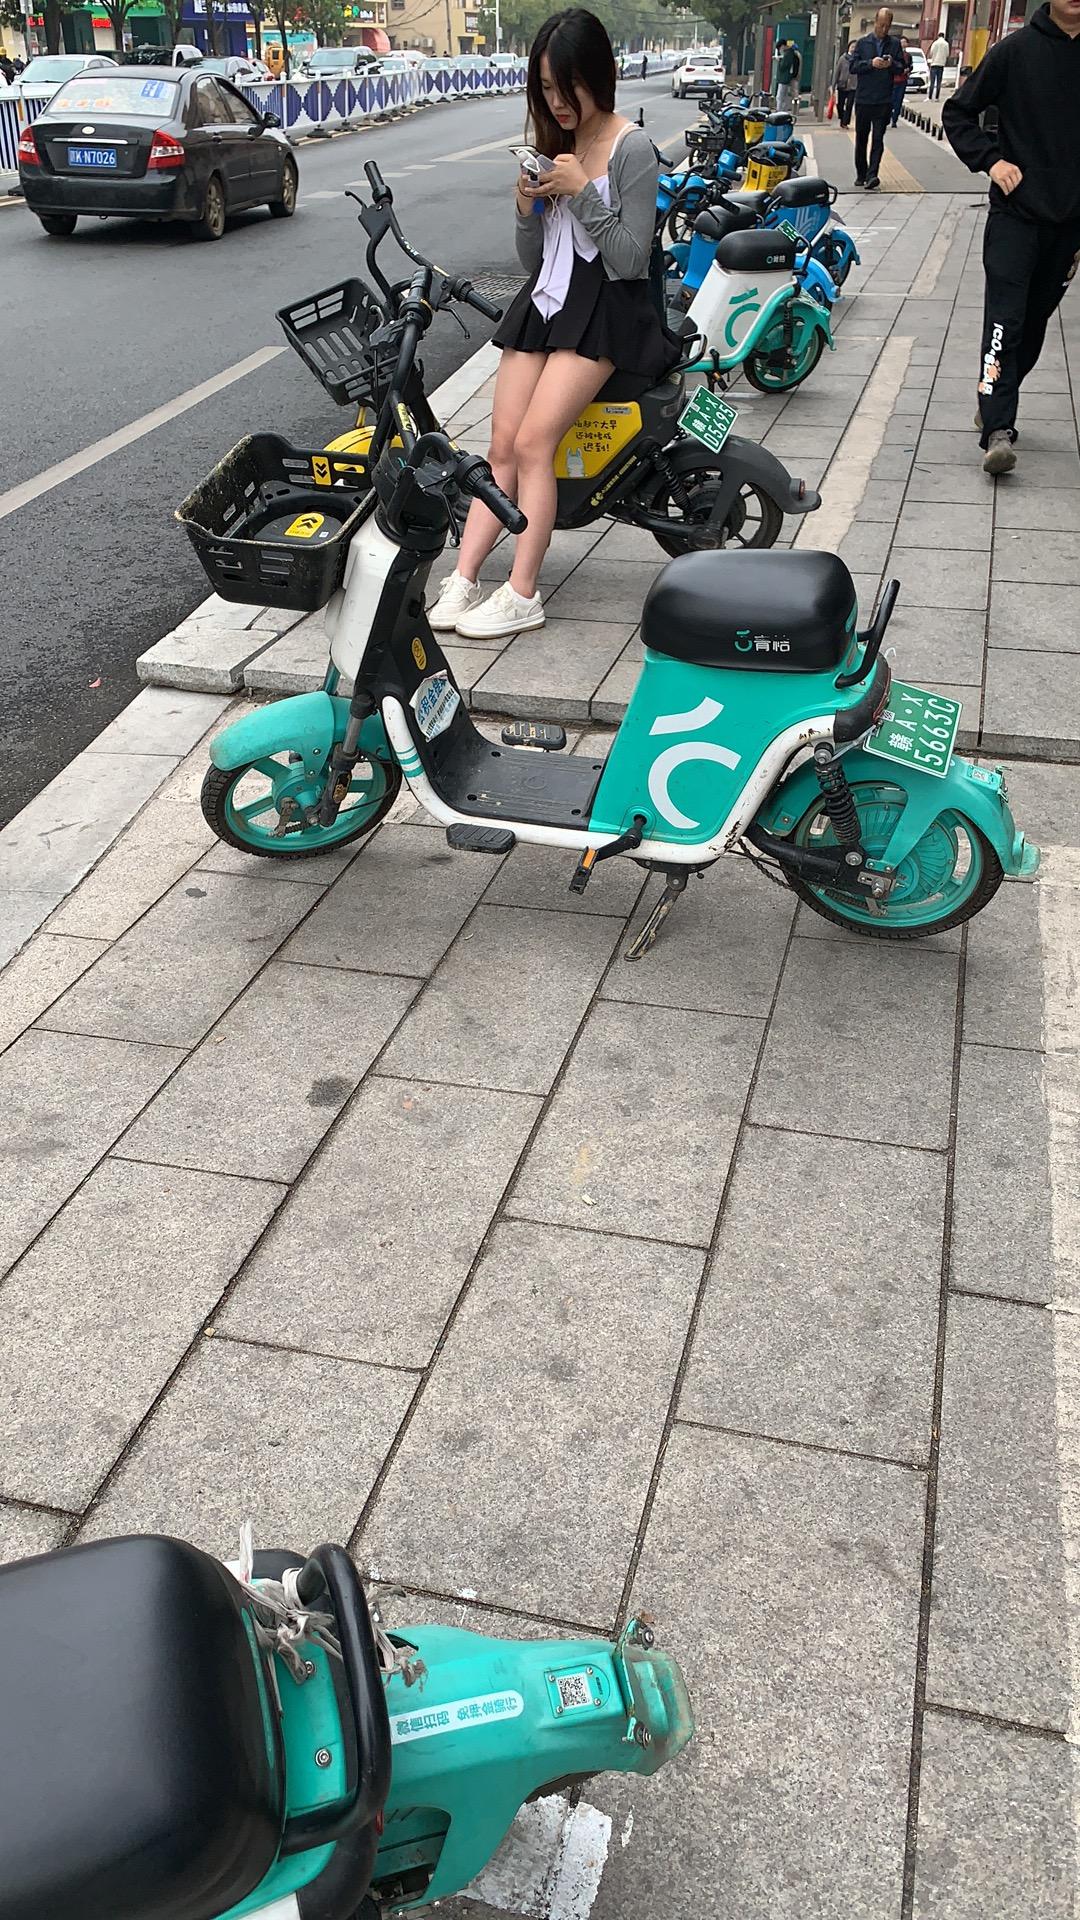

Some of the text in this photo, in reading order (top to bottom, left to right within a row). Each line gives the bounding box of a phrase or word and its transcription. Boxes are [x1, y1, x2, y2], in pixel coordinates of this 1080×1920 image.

[703, 403, 734, 447] D5695
[913, 698, 956, 767] 5663C
[396, 1698, 518, 1736] 微信扫码 免押金骑行
